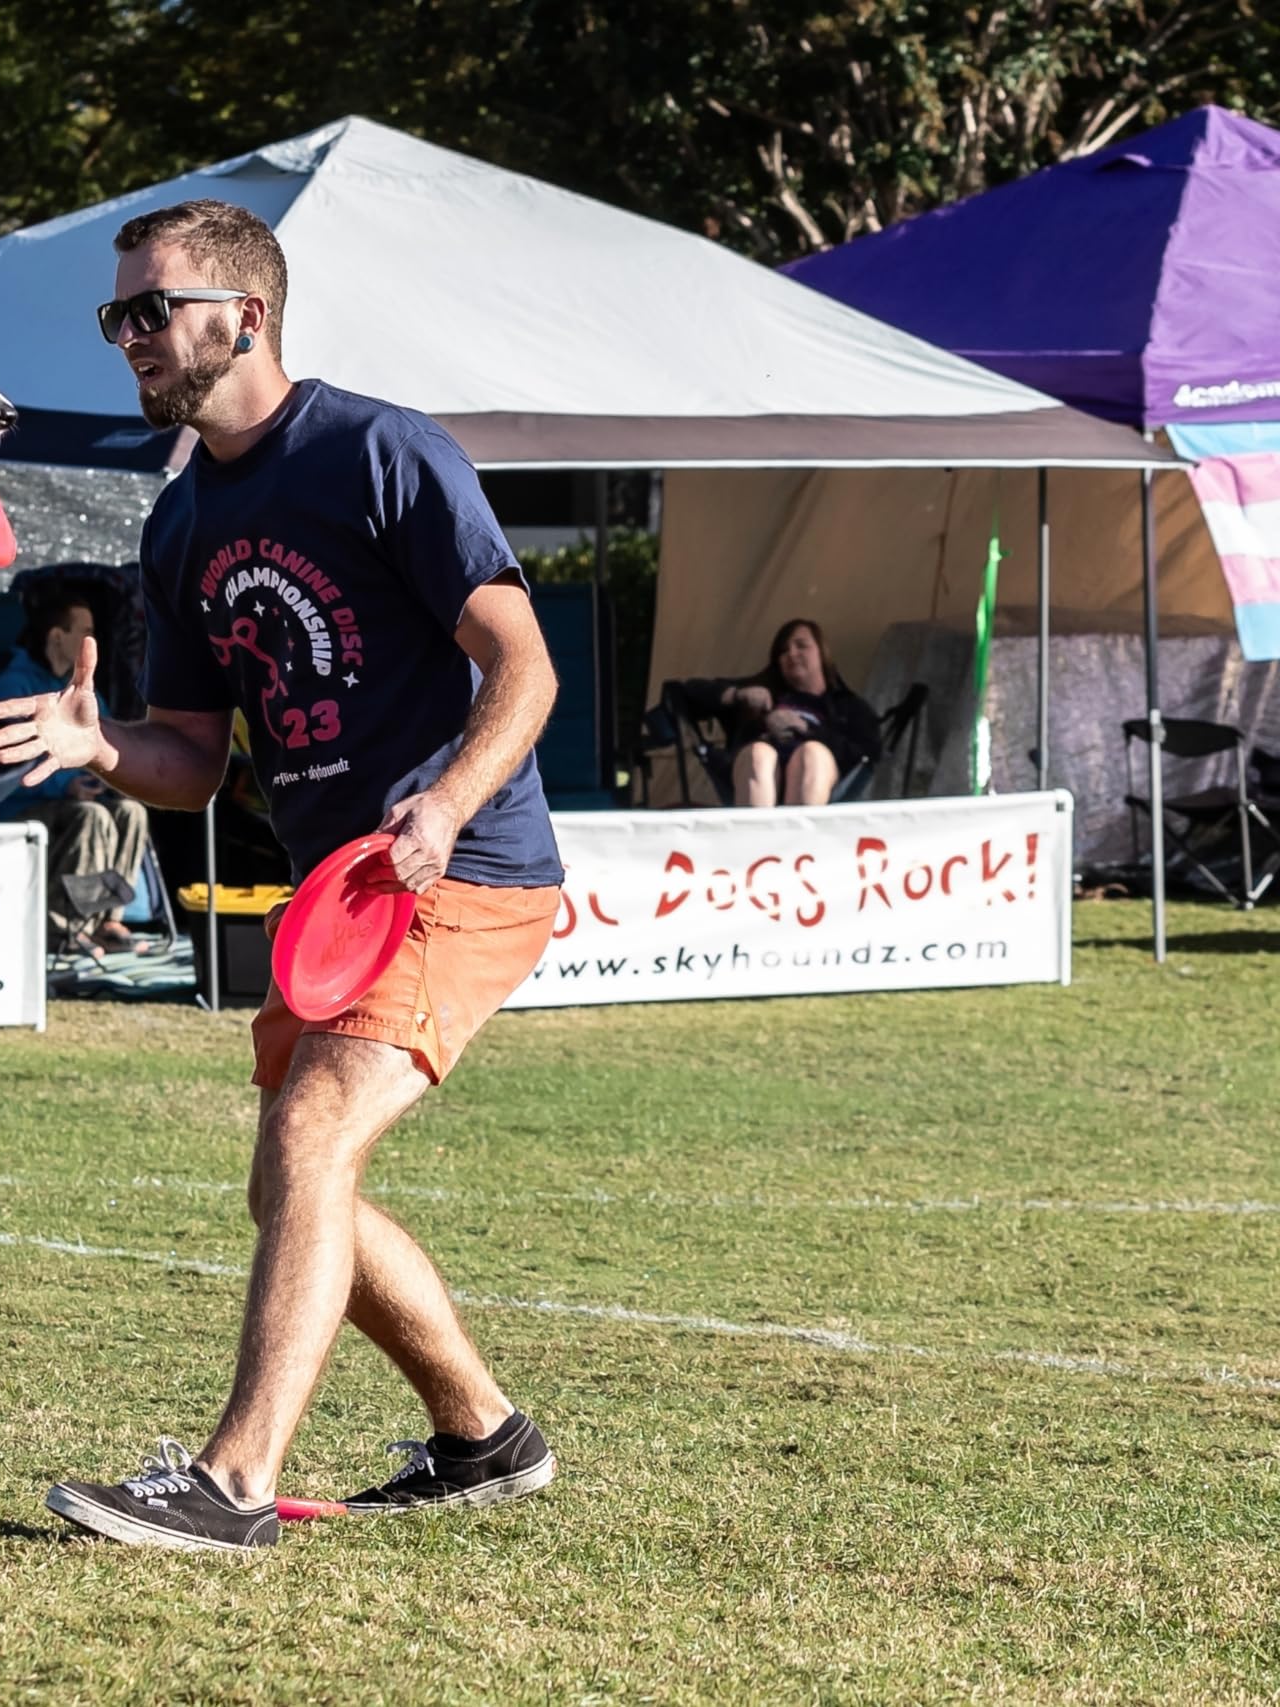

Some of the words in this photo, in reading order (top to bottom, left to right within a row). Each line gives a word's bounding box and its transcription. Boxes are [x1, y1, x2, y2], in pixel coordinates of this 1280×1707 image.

[200, 539, 252, 598] WORLD
[259, 538, 342, 604] CANINE
[331, 607, 363, 667] DISC
[225, 567, 331, 676] CHAMPIONSHIP
[283, 700, 342, 749] 23
